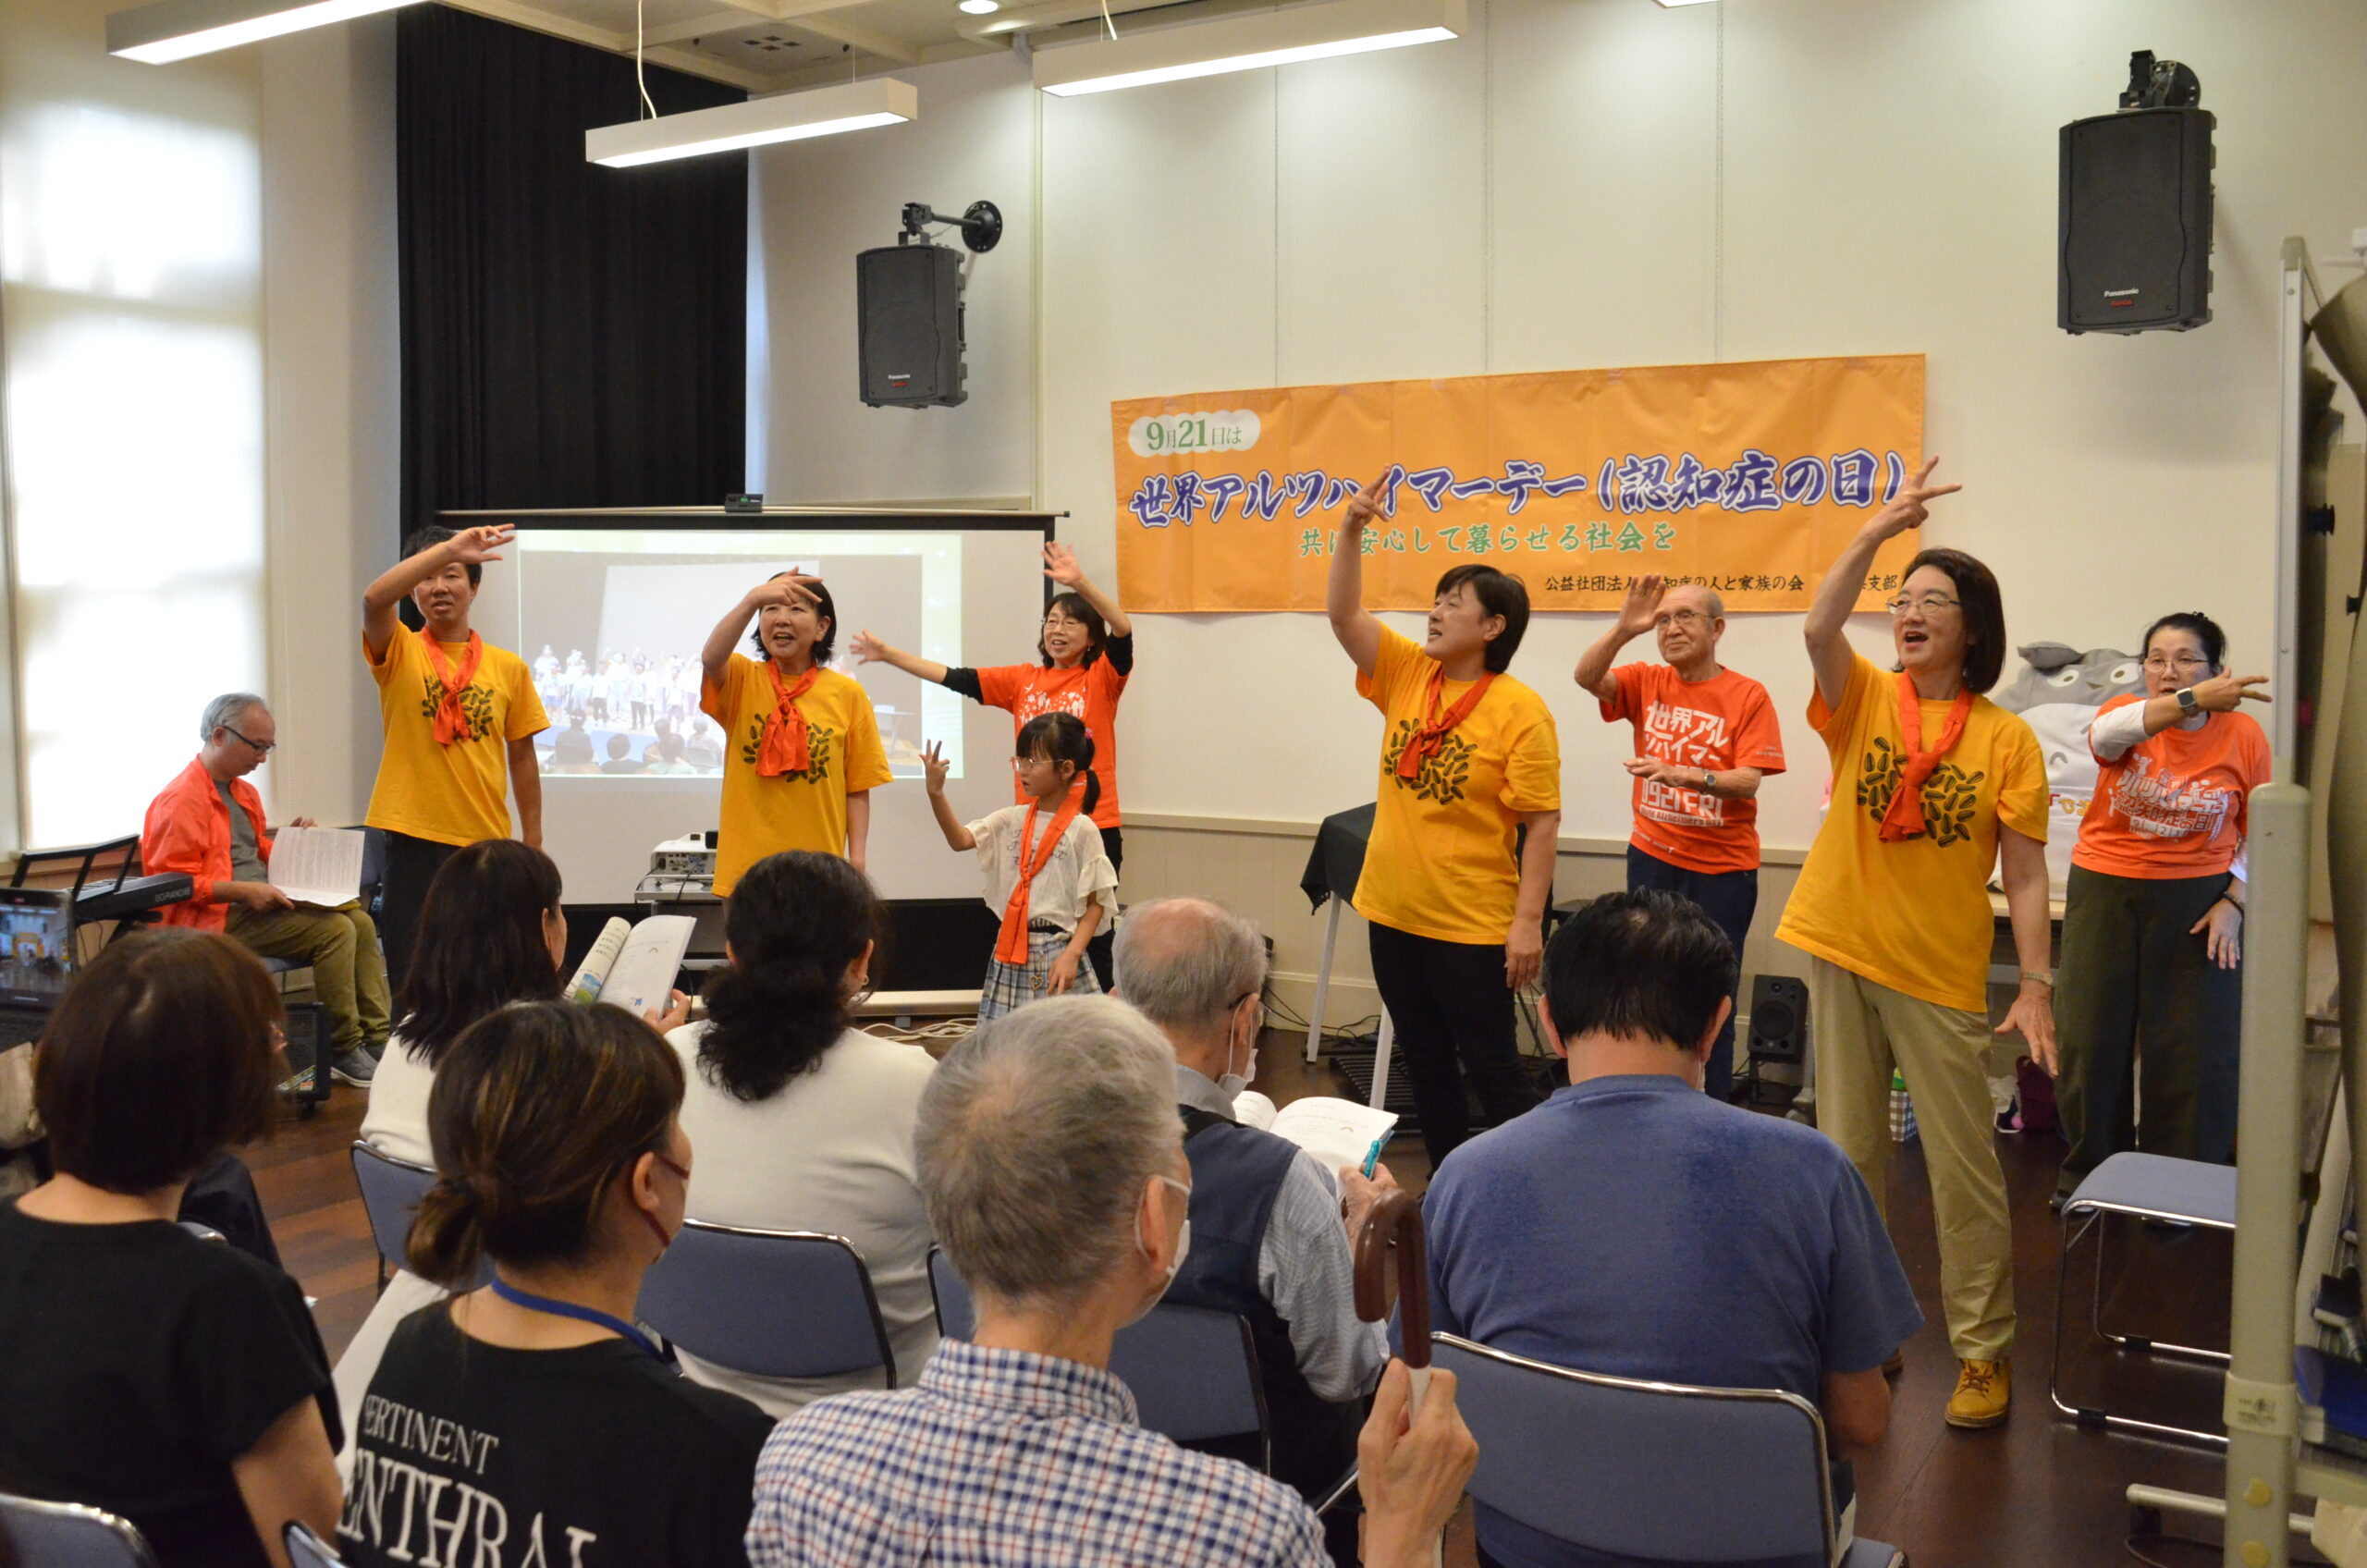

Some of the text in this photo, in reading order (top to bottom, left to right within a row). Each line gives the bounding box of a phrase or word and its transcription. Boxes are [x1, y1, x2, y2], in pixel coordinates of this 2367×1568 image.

[1146, 419, 1244, 451] 9月21日は
[1644, 700, 1729, 748] 世界アル
[1683, 791, 1723, 822] FRI
